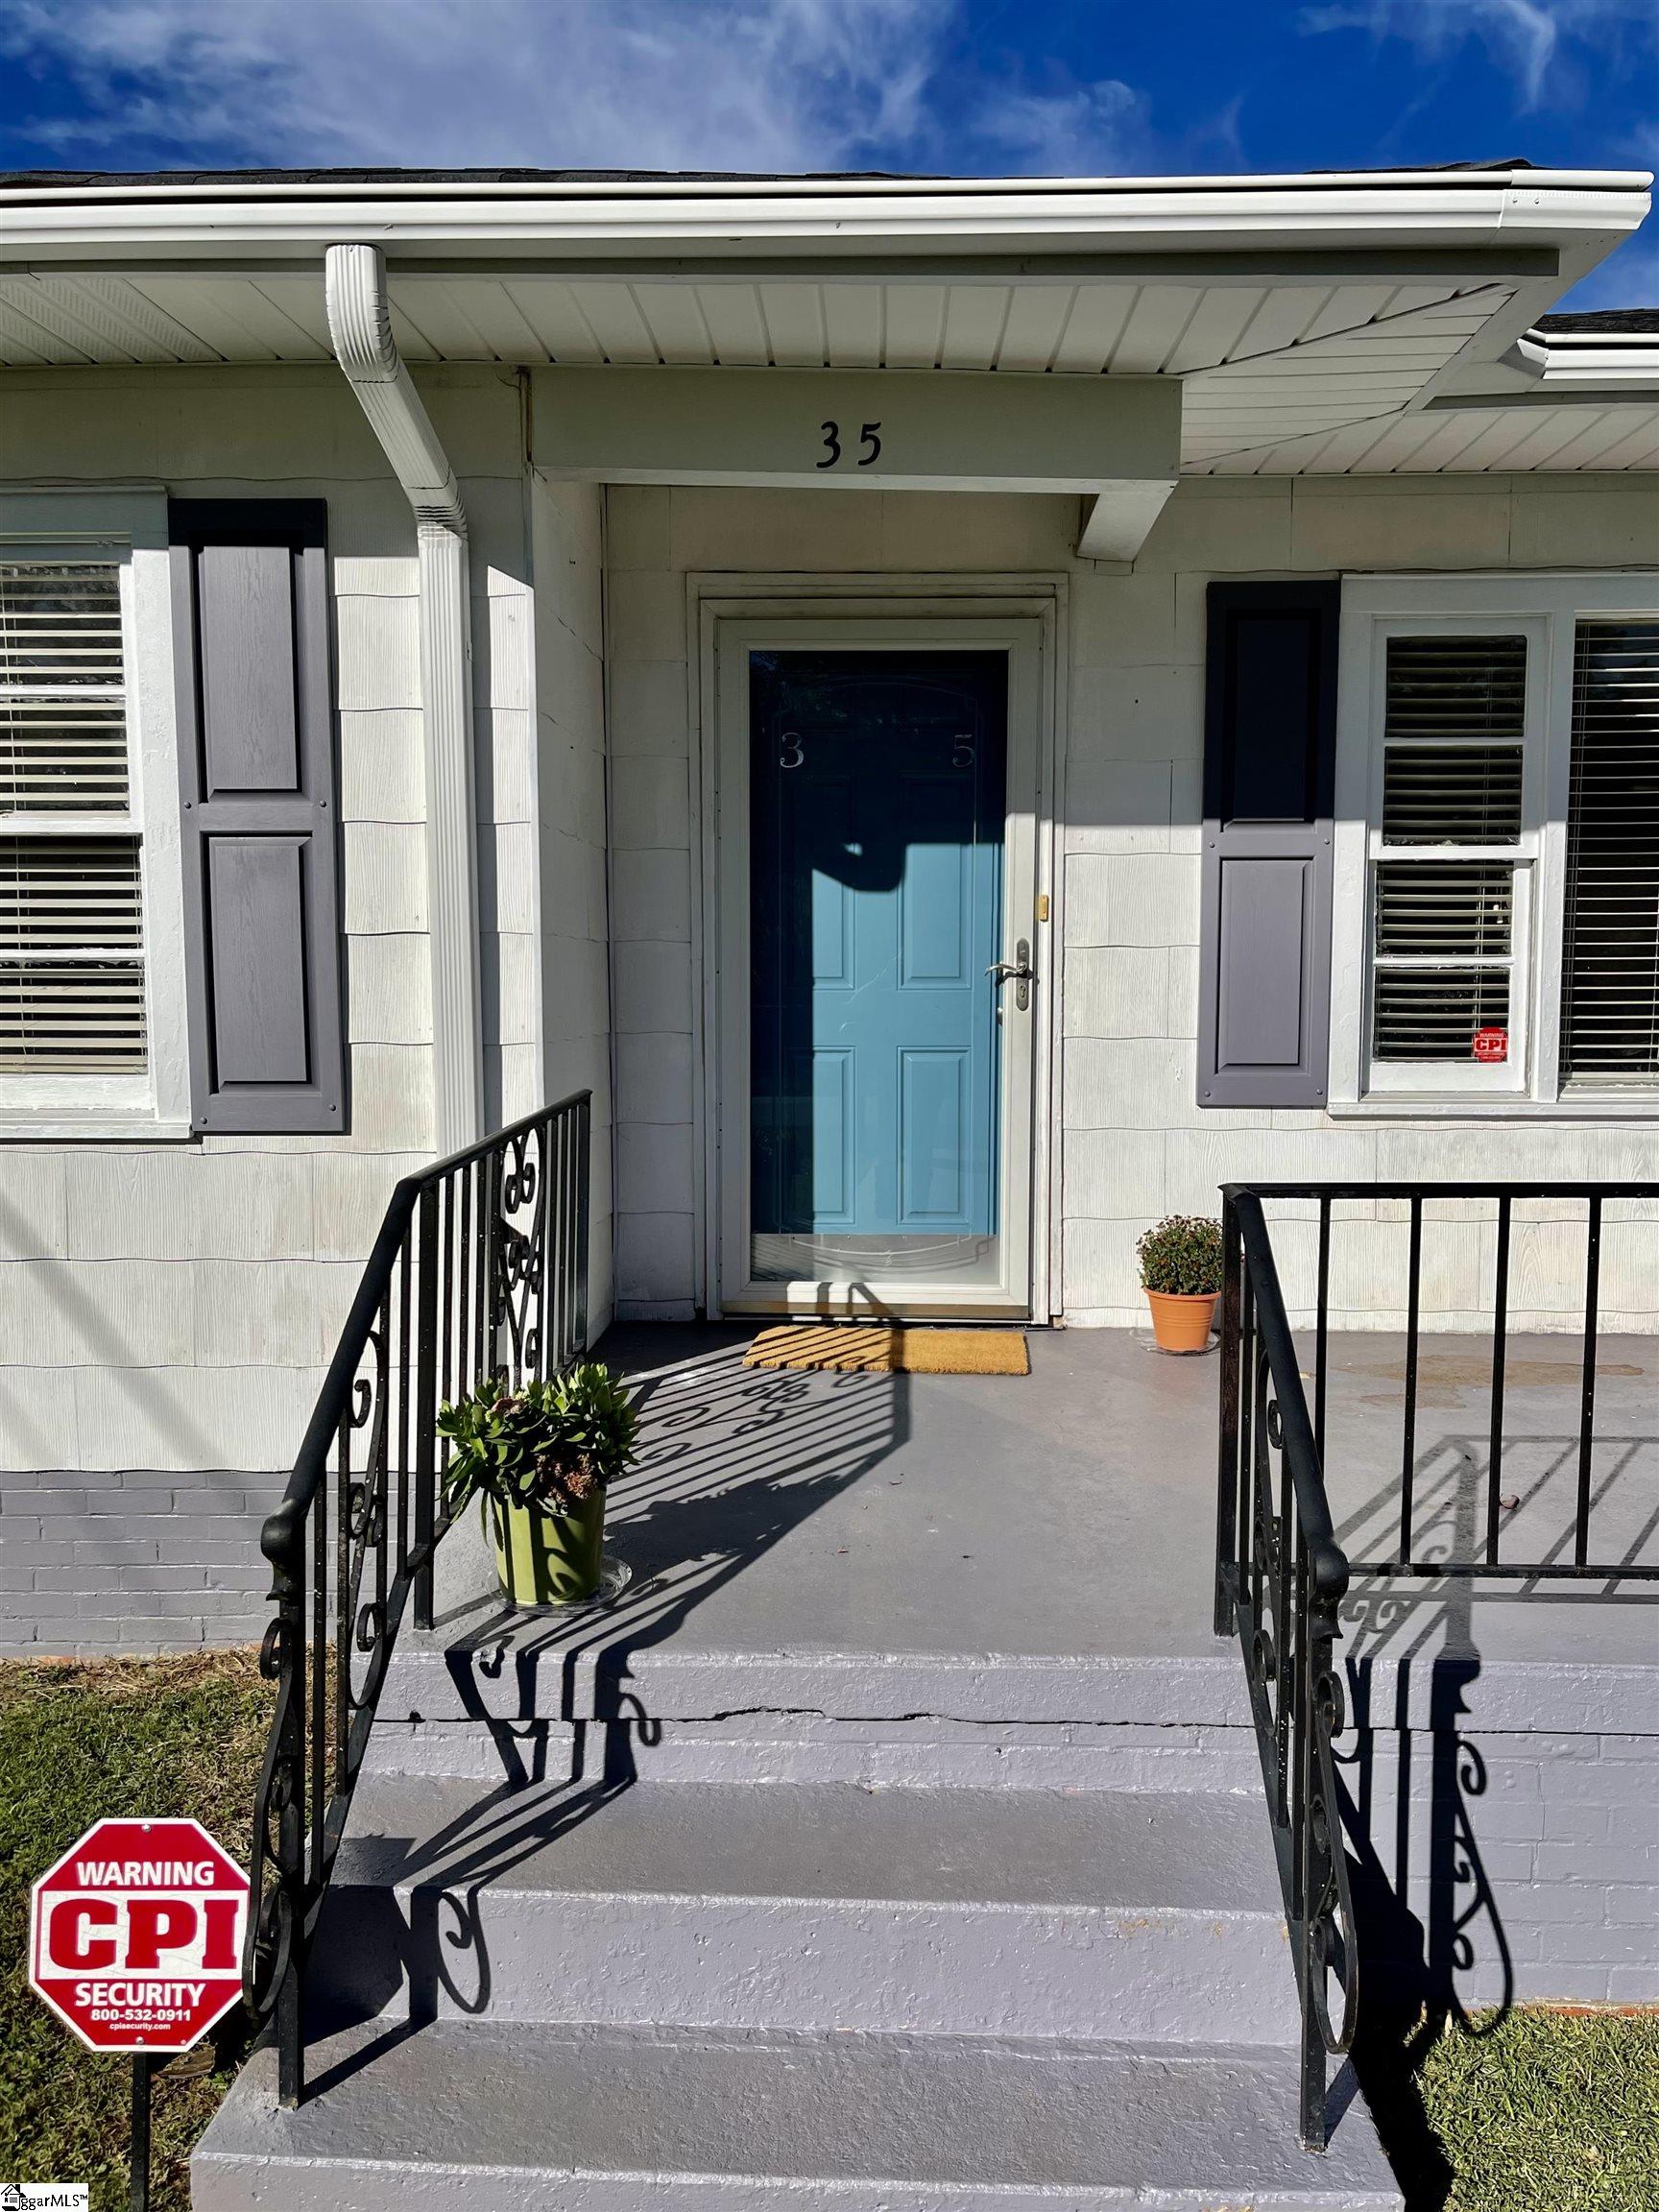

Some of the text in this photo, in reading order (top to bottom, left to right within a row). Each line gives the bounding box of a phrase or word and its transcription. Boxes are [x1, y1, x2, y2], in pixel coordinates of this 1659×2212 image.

[816, 421, 881, 469] 35
[780, 732, 975, 768] 3 5
[1476, 1039, 1506, 1050] CPI
[76, 1861, 214, 1887] WARNING
[49, 1898, 239, 1970] CPI
[74, 1983, 206, 2007] SECURITY
[90, 2008, 191, 2022] 800-532-0911
[108, 2023, 171, 2032] cpisecurity.com
